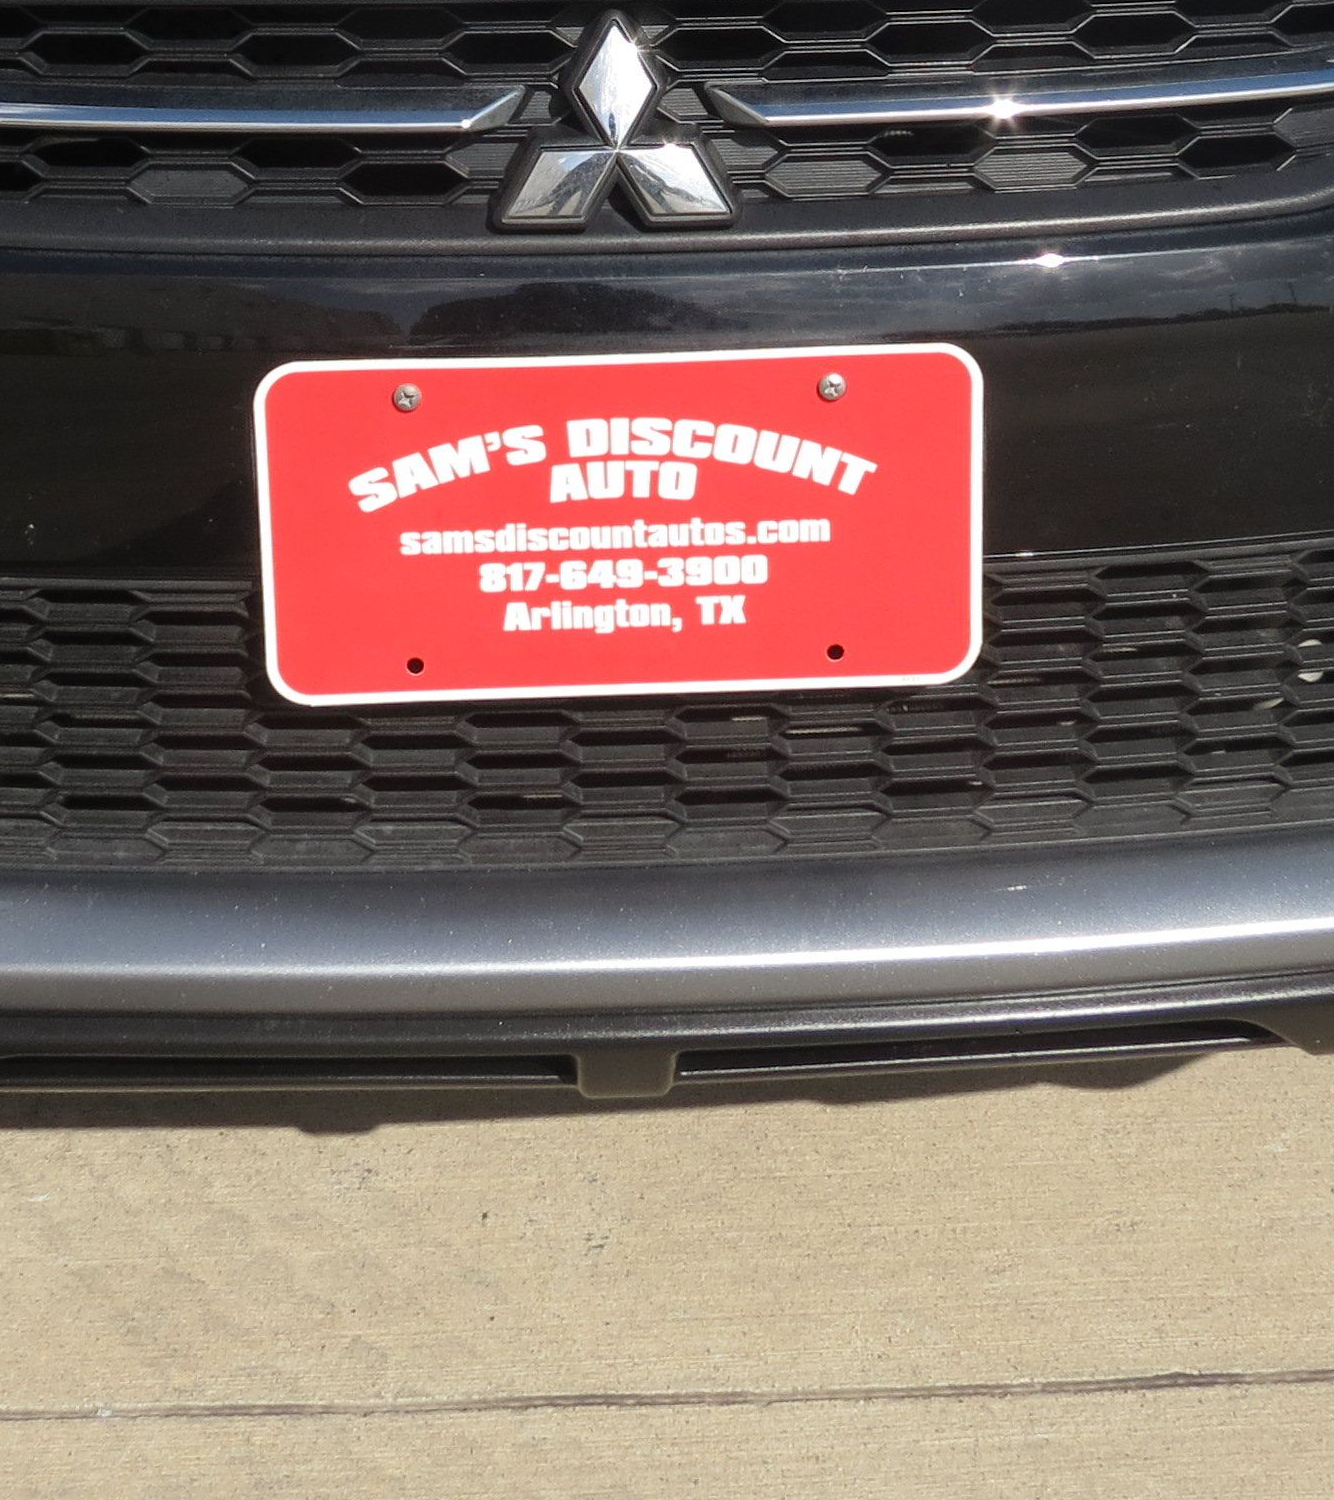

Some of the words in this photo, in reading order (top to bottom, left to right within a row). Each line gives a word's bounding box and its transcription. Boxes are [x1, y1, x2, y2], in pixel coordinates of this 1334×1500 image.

[348, 424, 547, 513] SAM'S
[566, 417, 878, 496] DISCOUNT
[549, 460, 699, 504] AUTO
[399, 517, 831, 556] samsdiscountautos.com
[478, 554, 769, 593] 817-649-3900
[502, 598, 683, 634] Arlington,
[695, 594, 747, 626] TX
